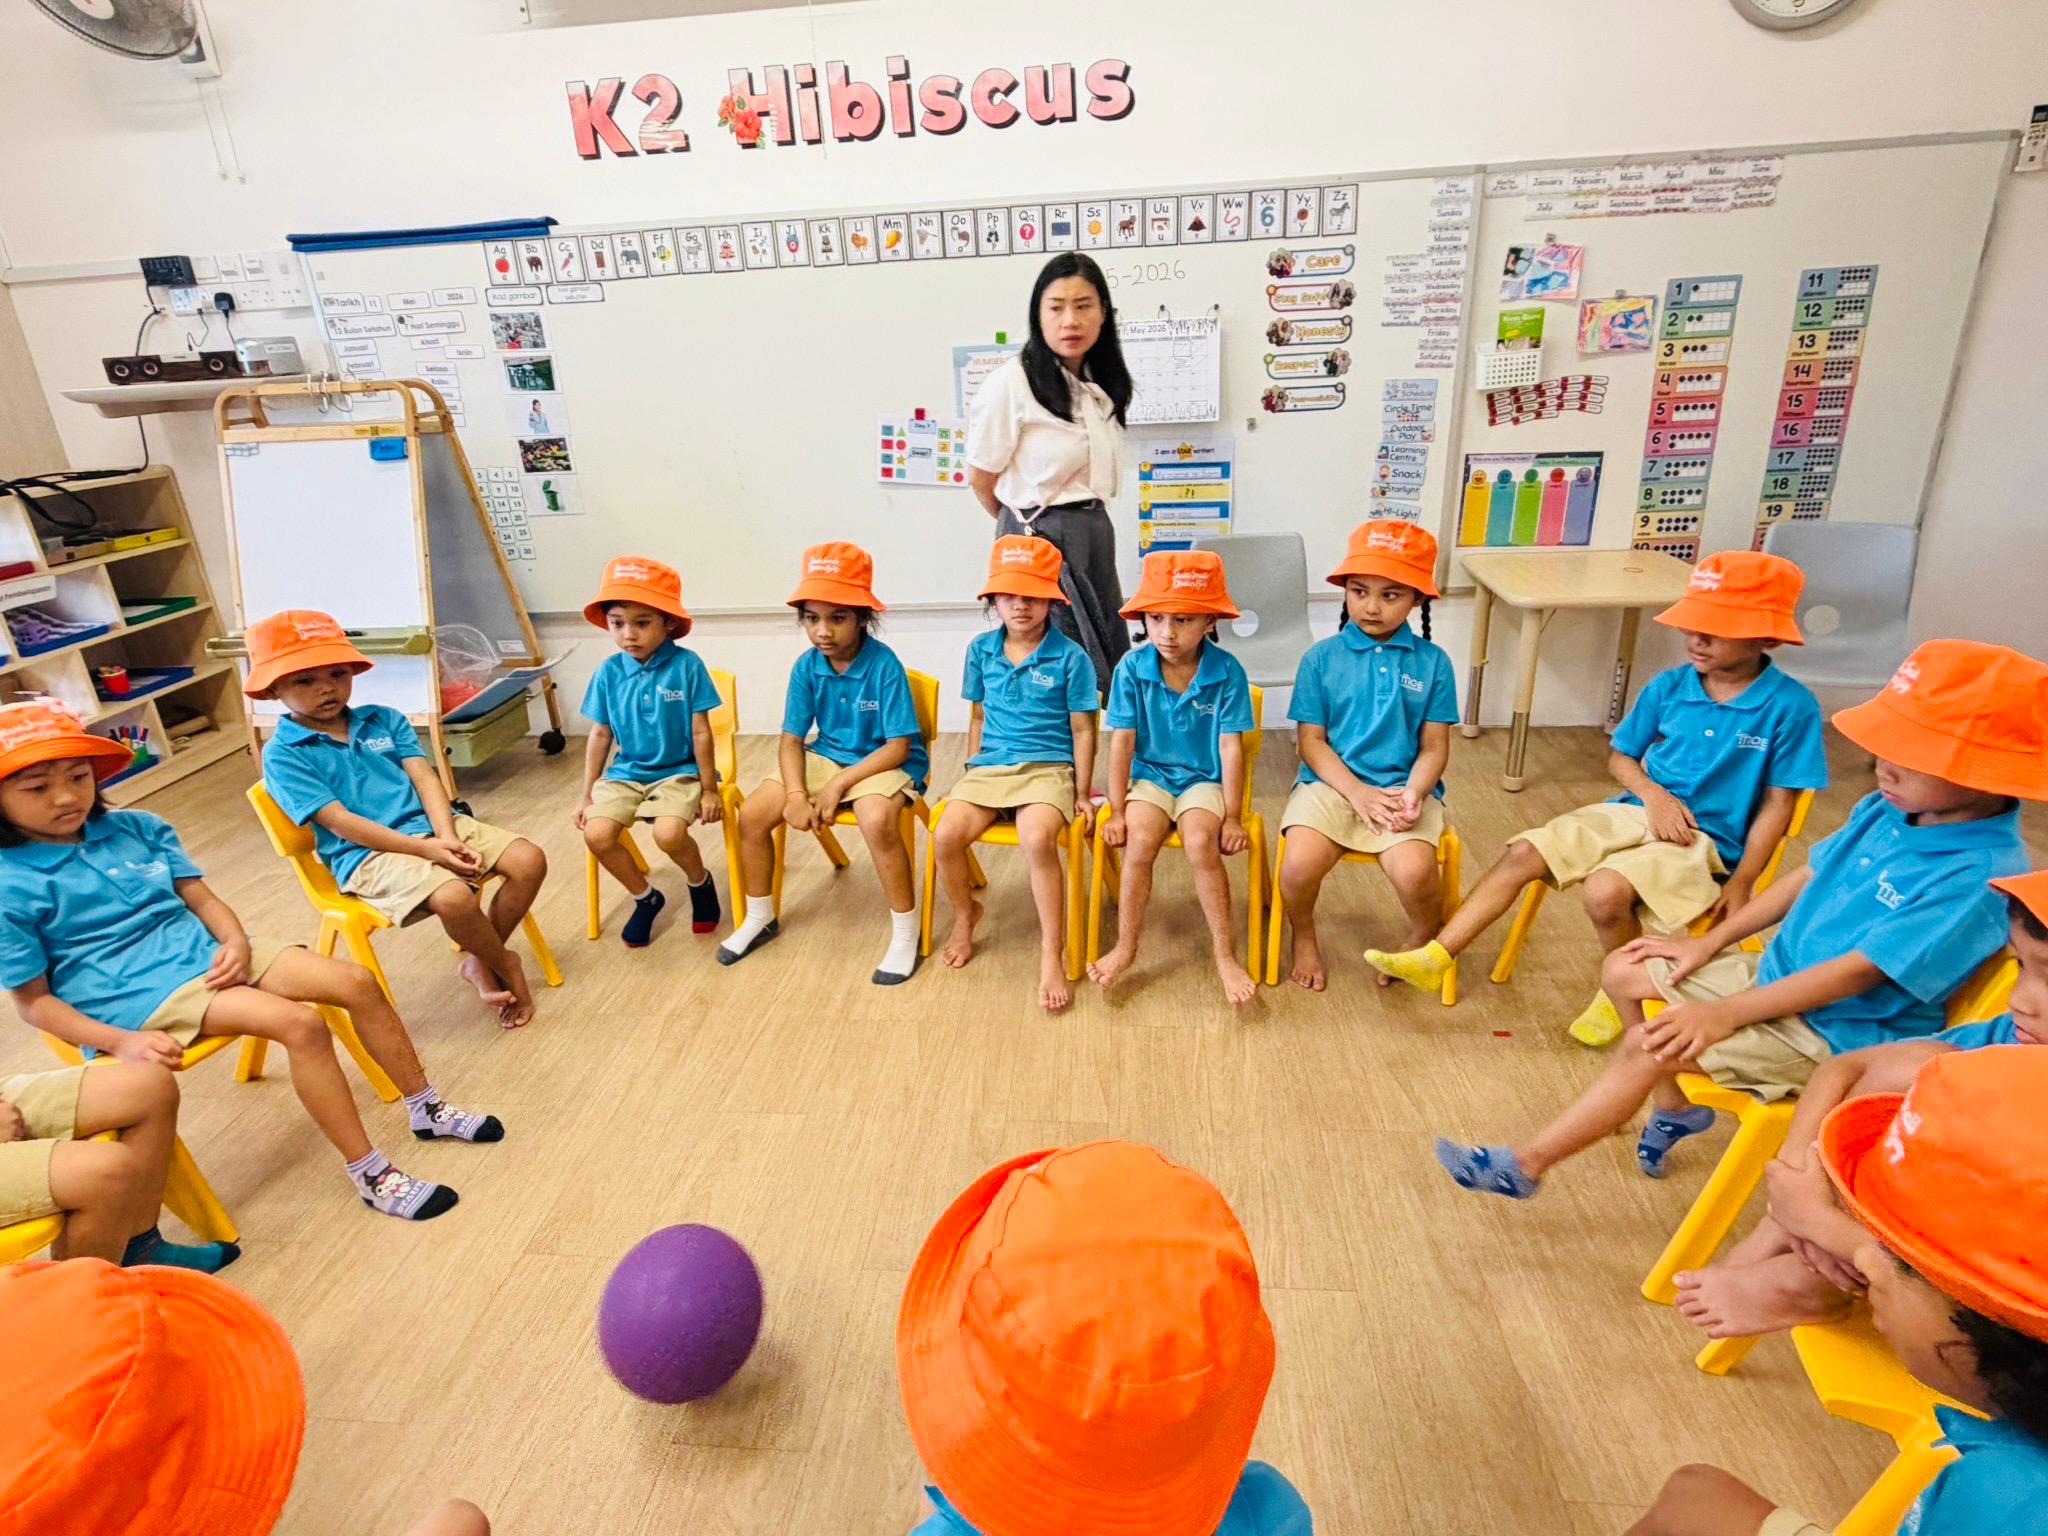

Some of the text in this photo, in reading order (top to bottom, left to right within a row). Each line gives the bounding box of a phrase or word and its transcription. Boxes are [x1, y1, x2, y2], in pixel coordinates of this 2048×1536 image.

[566, 55, 1134, 160] K2 Hibiscus
[1532, 164, 1771, 186] January February March April May June
[1260, 195, 1276, 206] Xx
[1296, 194, 1310, 206] Yy
[1334, 191, 1347, 201] Zz
[1120, 204, 1132, 214] Tt
[1154, 204, 1168, 214] Uu
[1191, 200, 1204, 210] Vv
[1222, 198, 1243, 209] Ww
[1536, 202, 1553, 212] July
[1574, 201, 1599, 210] August
[1654, 196, 1685, 204] October
[1055, 209, 1067, 218] Rr
[1087, 208, 1101, 218] Ss
[1436, 208, 1463, 217] Sunday
[883, 219, 902, 230] Mm
[919, 217, 934, 227] Nn
[951, 215, 966, 226] Oo
[987, 213, 999, 226] Pp
[818, 224, 831, 234] Kk
[854, 222, 864, 232] Ll
[718, 230, 732, 240] Hh
[753, 228, 763, 238] Ii
[1434, 234, 1462, 242] Monday
[558, 242, 571, 252] Cc
[620, 237, 633, 248] Ee
[525, 244, 538, 254] Bb
[1306, 254, 1342, 268] Care
[1432, 258, 1461, 267] Tuesday
[1808, 272, 1824, 288] 11
[1675, 282, 1683, 296] 1
[335, 298, 361, 307] Tarikh
[1424, 306, 1457, 314] Thursday
[1804, 302, 1822, 318] 12
[1668, 312, 1679, 326] 2
[1296, 324, 1348, 339] Honesty
[1428, 329, 1450, 337] Friday
[1798, 334, 1816, 349] 13
[1663, 343, 1674, 357] 3
[1794, 364, 1812, 378] 14
[1660, 373, 1671, 386] 4
[1402, 382, 1420, 390] Daily
[1786, 394, 1804, 408] 15
[1384, 404, 1433, 413] Circle Time
[1656, 402, 1666, 416] 5
[1390, 424, 1426, 432] Outdoor
[1782, 422, 1800, 436] 16
[1399, 432, 1417, 441] Play
[1652, 432, 1662, 445] 6
[1390, 446, 1426, 456] Learning
[1390, 454, 1418, 462] Centre
[1777, 452, 1796, 464] 17
[1648, 460, 1658, 473] 7
[1392, 469, 1422, 479] Snack
[1772, 477, 1790, 490] 18
[1643, 488, 1653, 501] 8
[1766, 504, 1783, 517] 19
[1640, 515, 1650, 528] 9
